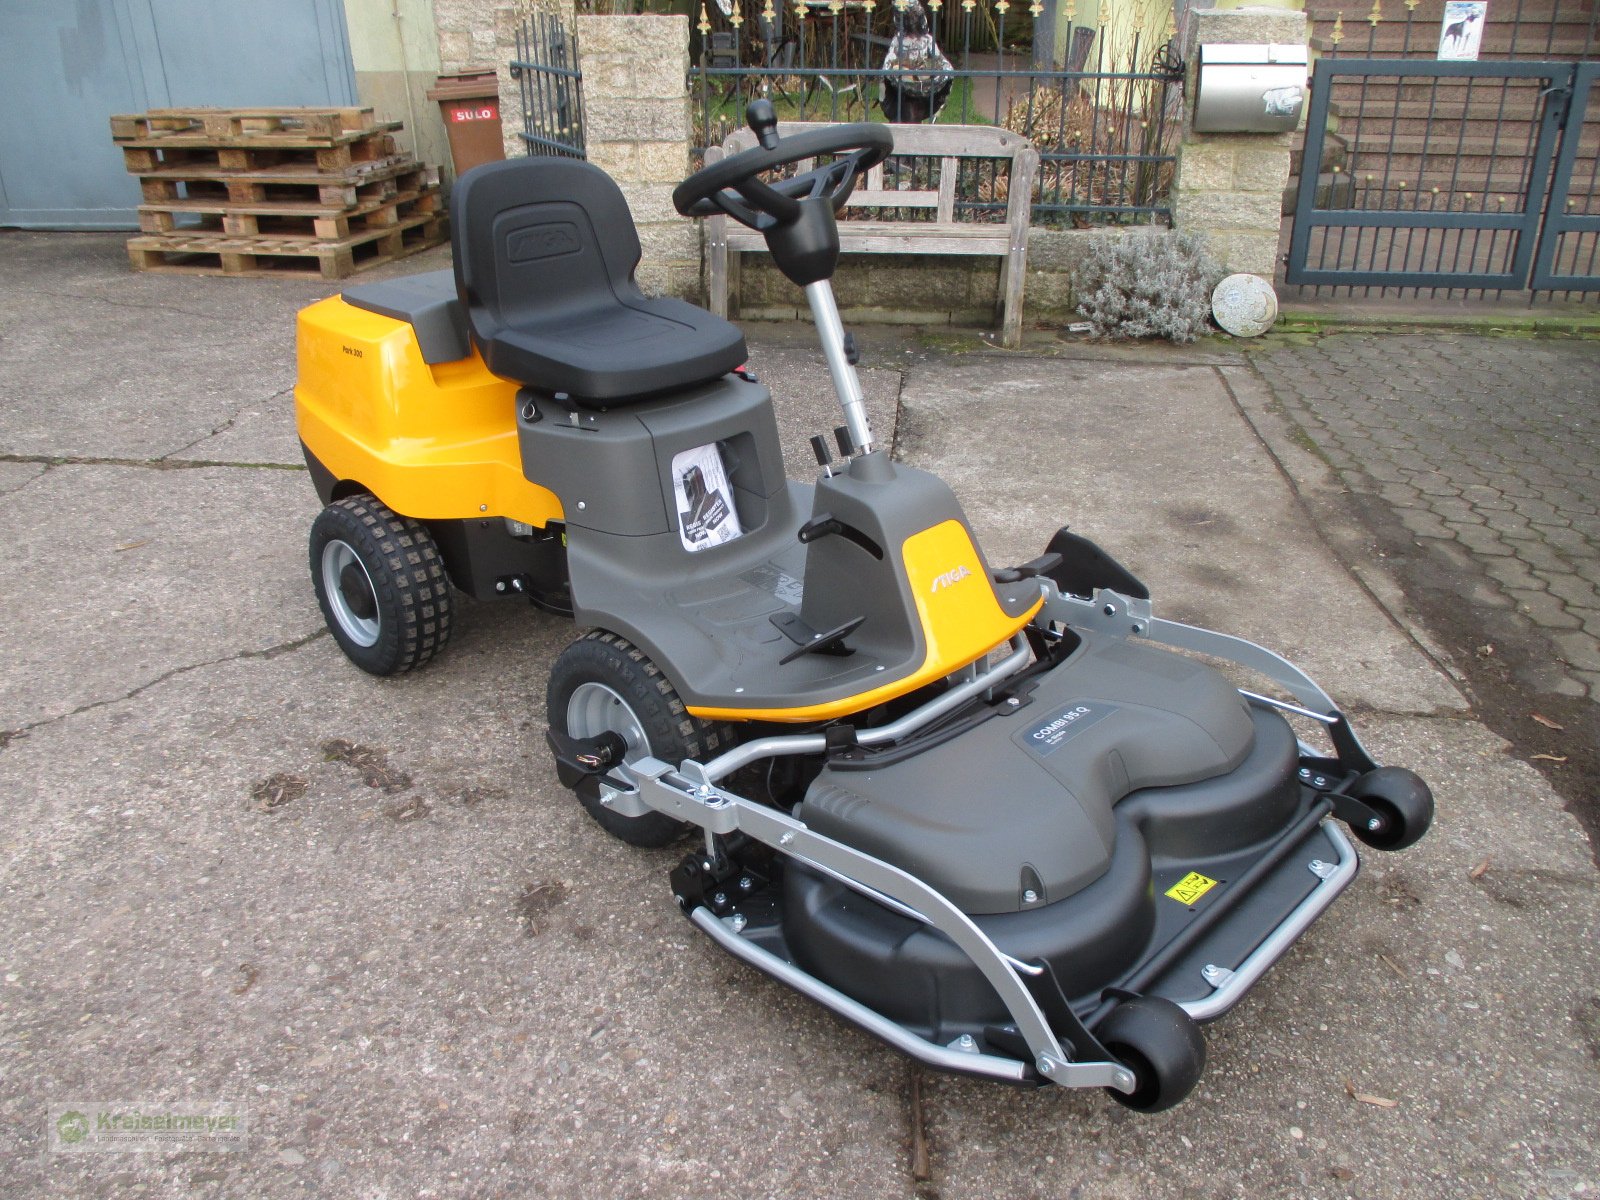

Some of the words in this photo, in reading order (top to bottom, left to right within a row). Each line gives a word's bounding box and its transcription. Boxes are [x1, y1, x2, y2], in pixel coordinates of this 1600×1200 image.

[456, 109, 491, 121] SULO
[712, 513, 723, 525] NOW
[931, 565, 972, 592] STIGA
[1033, 718, 1068, 739] COMBI
